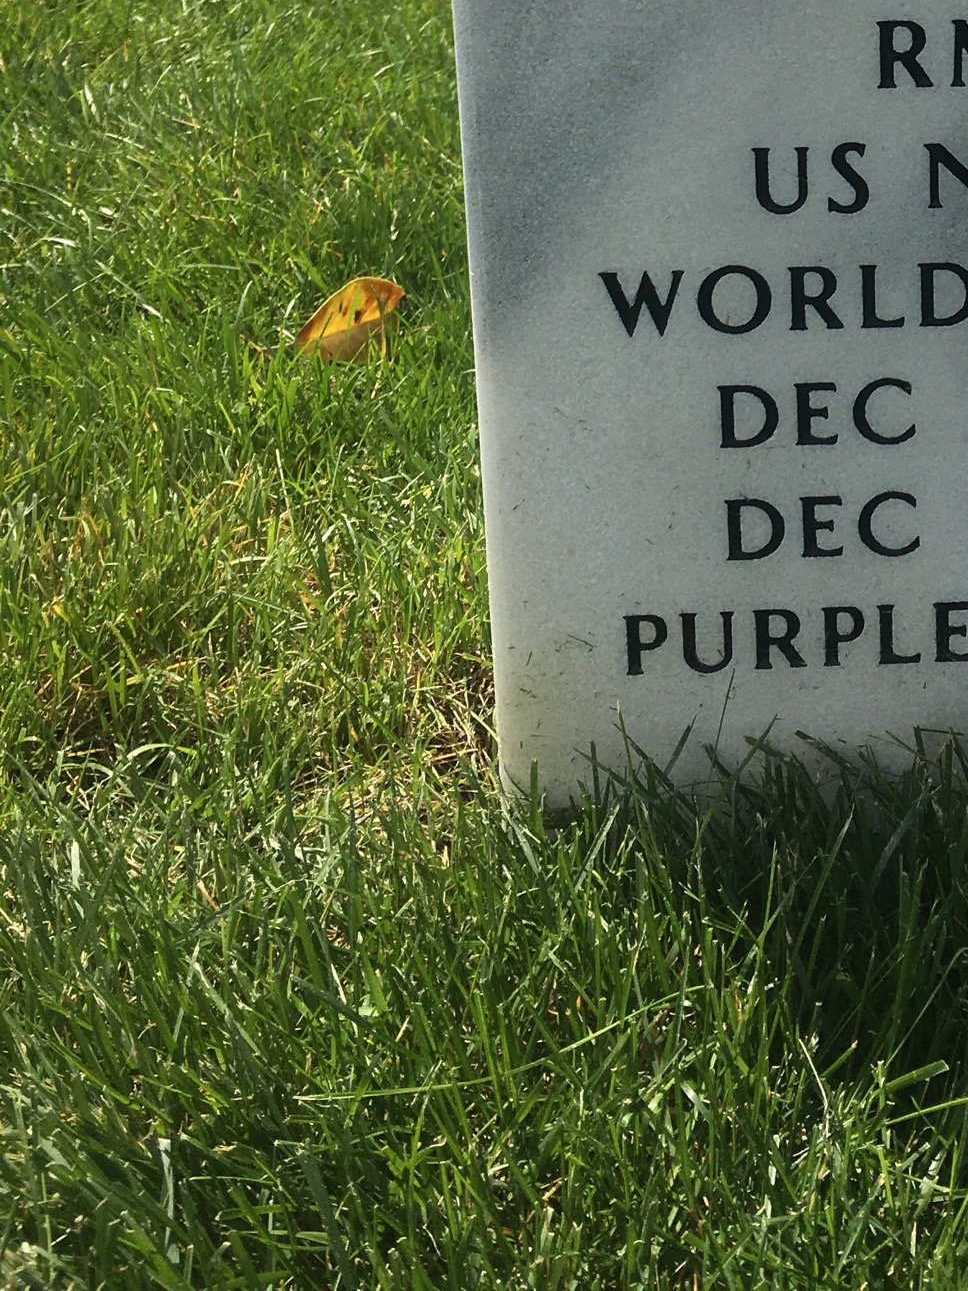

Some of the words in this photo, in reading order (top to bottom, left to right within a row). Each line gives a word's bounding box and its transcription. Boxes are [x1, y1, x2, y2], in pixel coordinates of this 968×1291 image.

[751, 142, 869, 215] US
[717, 377, 916, 449] DEC
[724, 490, 920, 561] DEC
